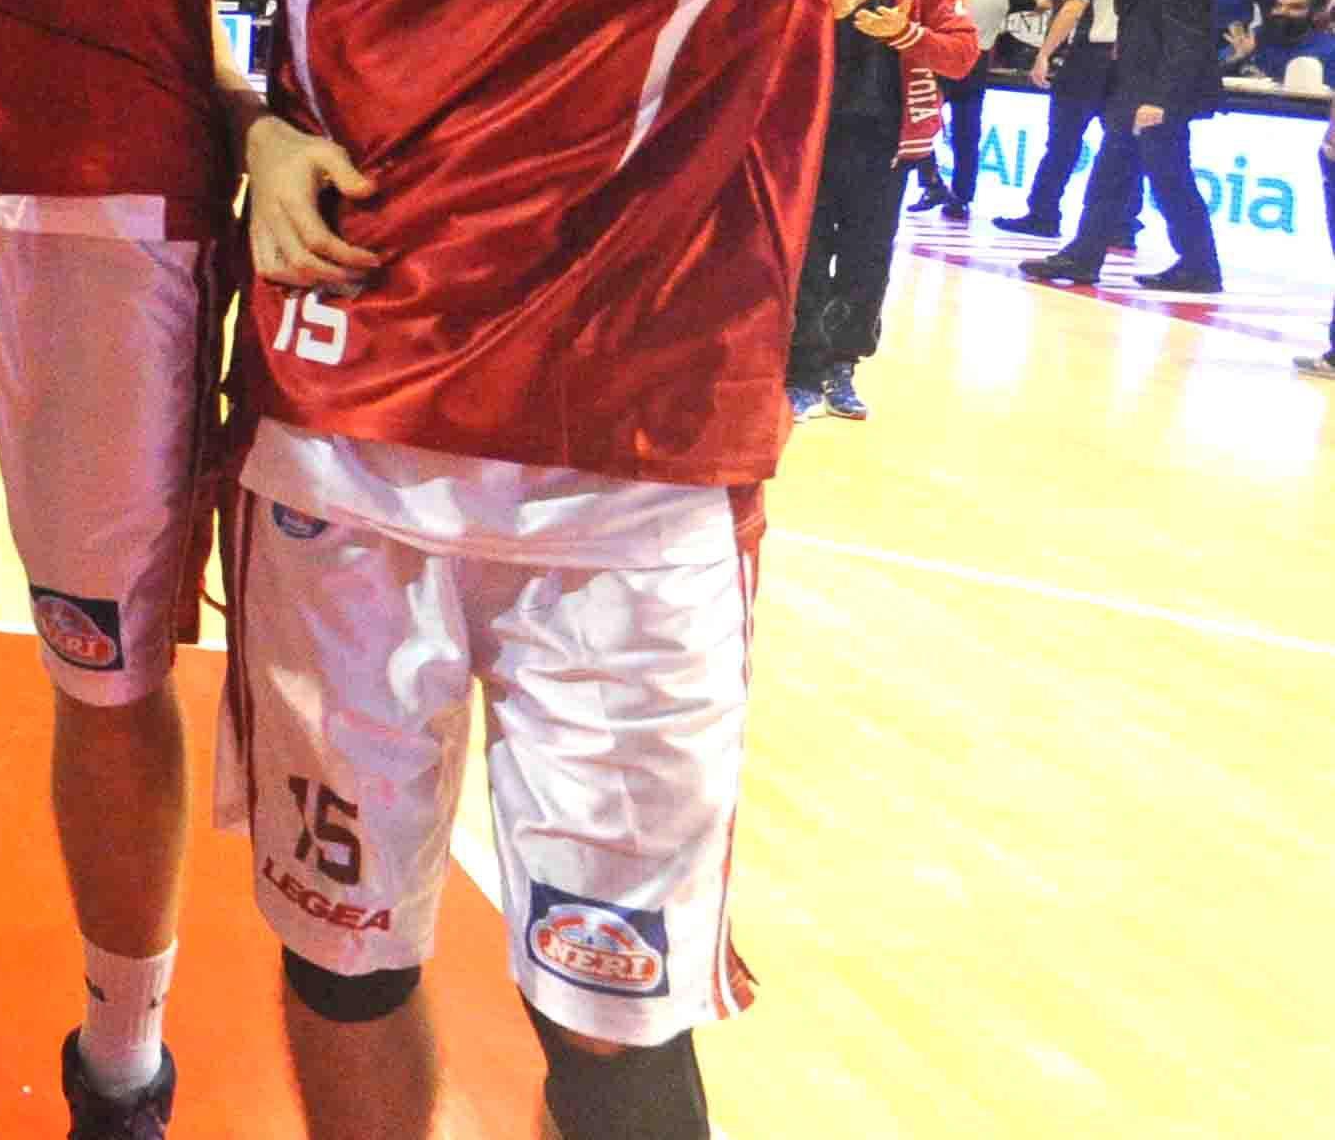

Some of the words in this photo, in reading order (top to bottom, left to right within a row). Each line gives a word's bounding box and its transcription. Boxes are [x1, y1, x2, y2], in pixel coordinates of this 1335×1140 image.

[272, 291, 349, 366] 15
[288, 774, 362, 885] 15
[262, 856, 392, 932] LEGEA
[542, 934, 647, 983] NERI
